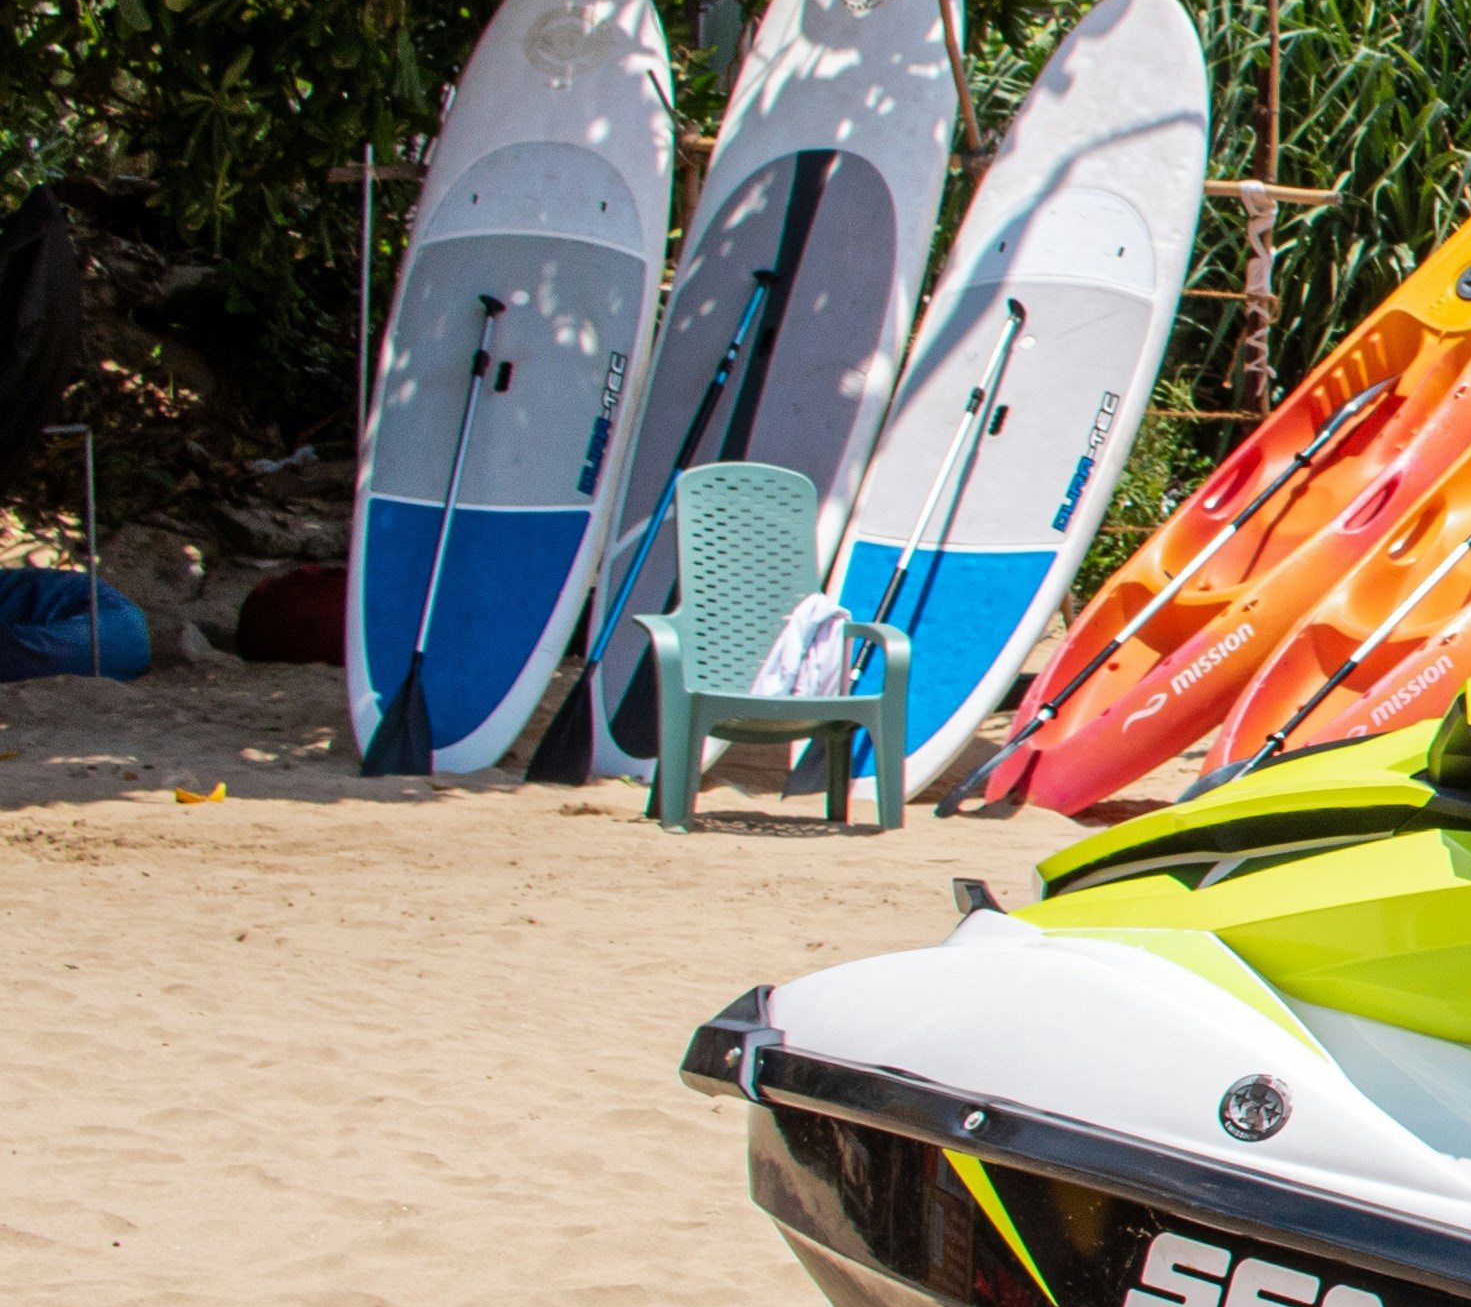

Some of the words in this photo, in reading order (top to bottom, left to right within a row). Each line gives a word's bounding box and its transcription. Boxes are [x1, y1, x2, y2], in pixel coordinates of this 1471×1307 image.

[1052, 391, 1120, 533] DURA-TEC
[1170, 621, 1257, 695] mission
[1370, 654, 1454, 726] mission
